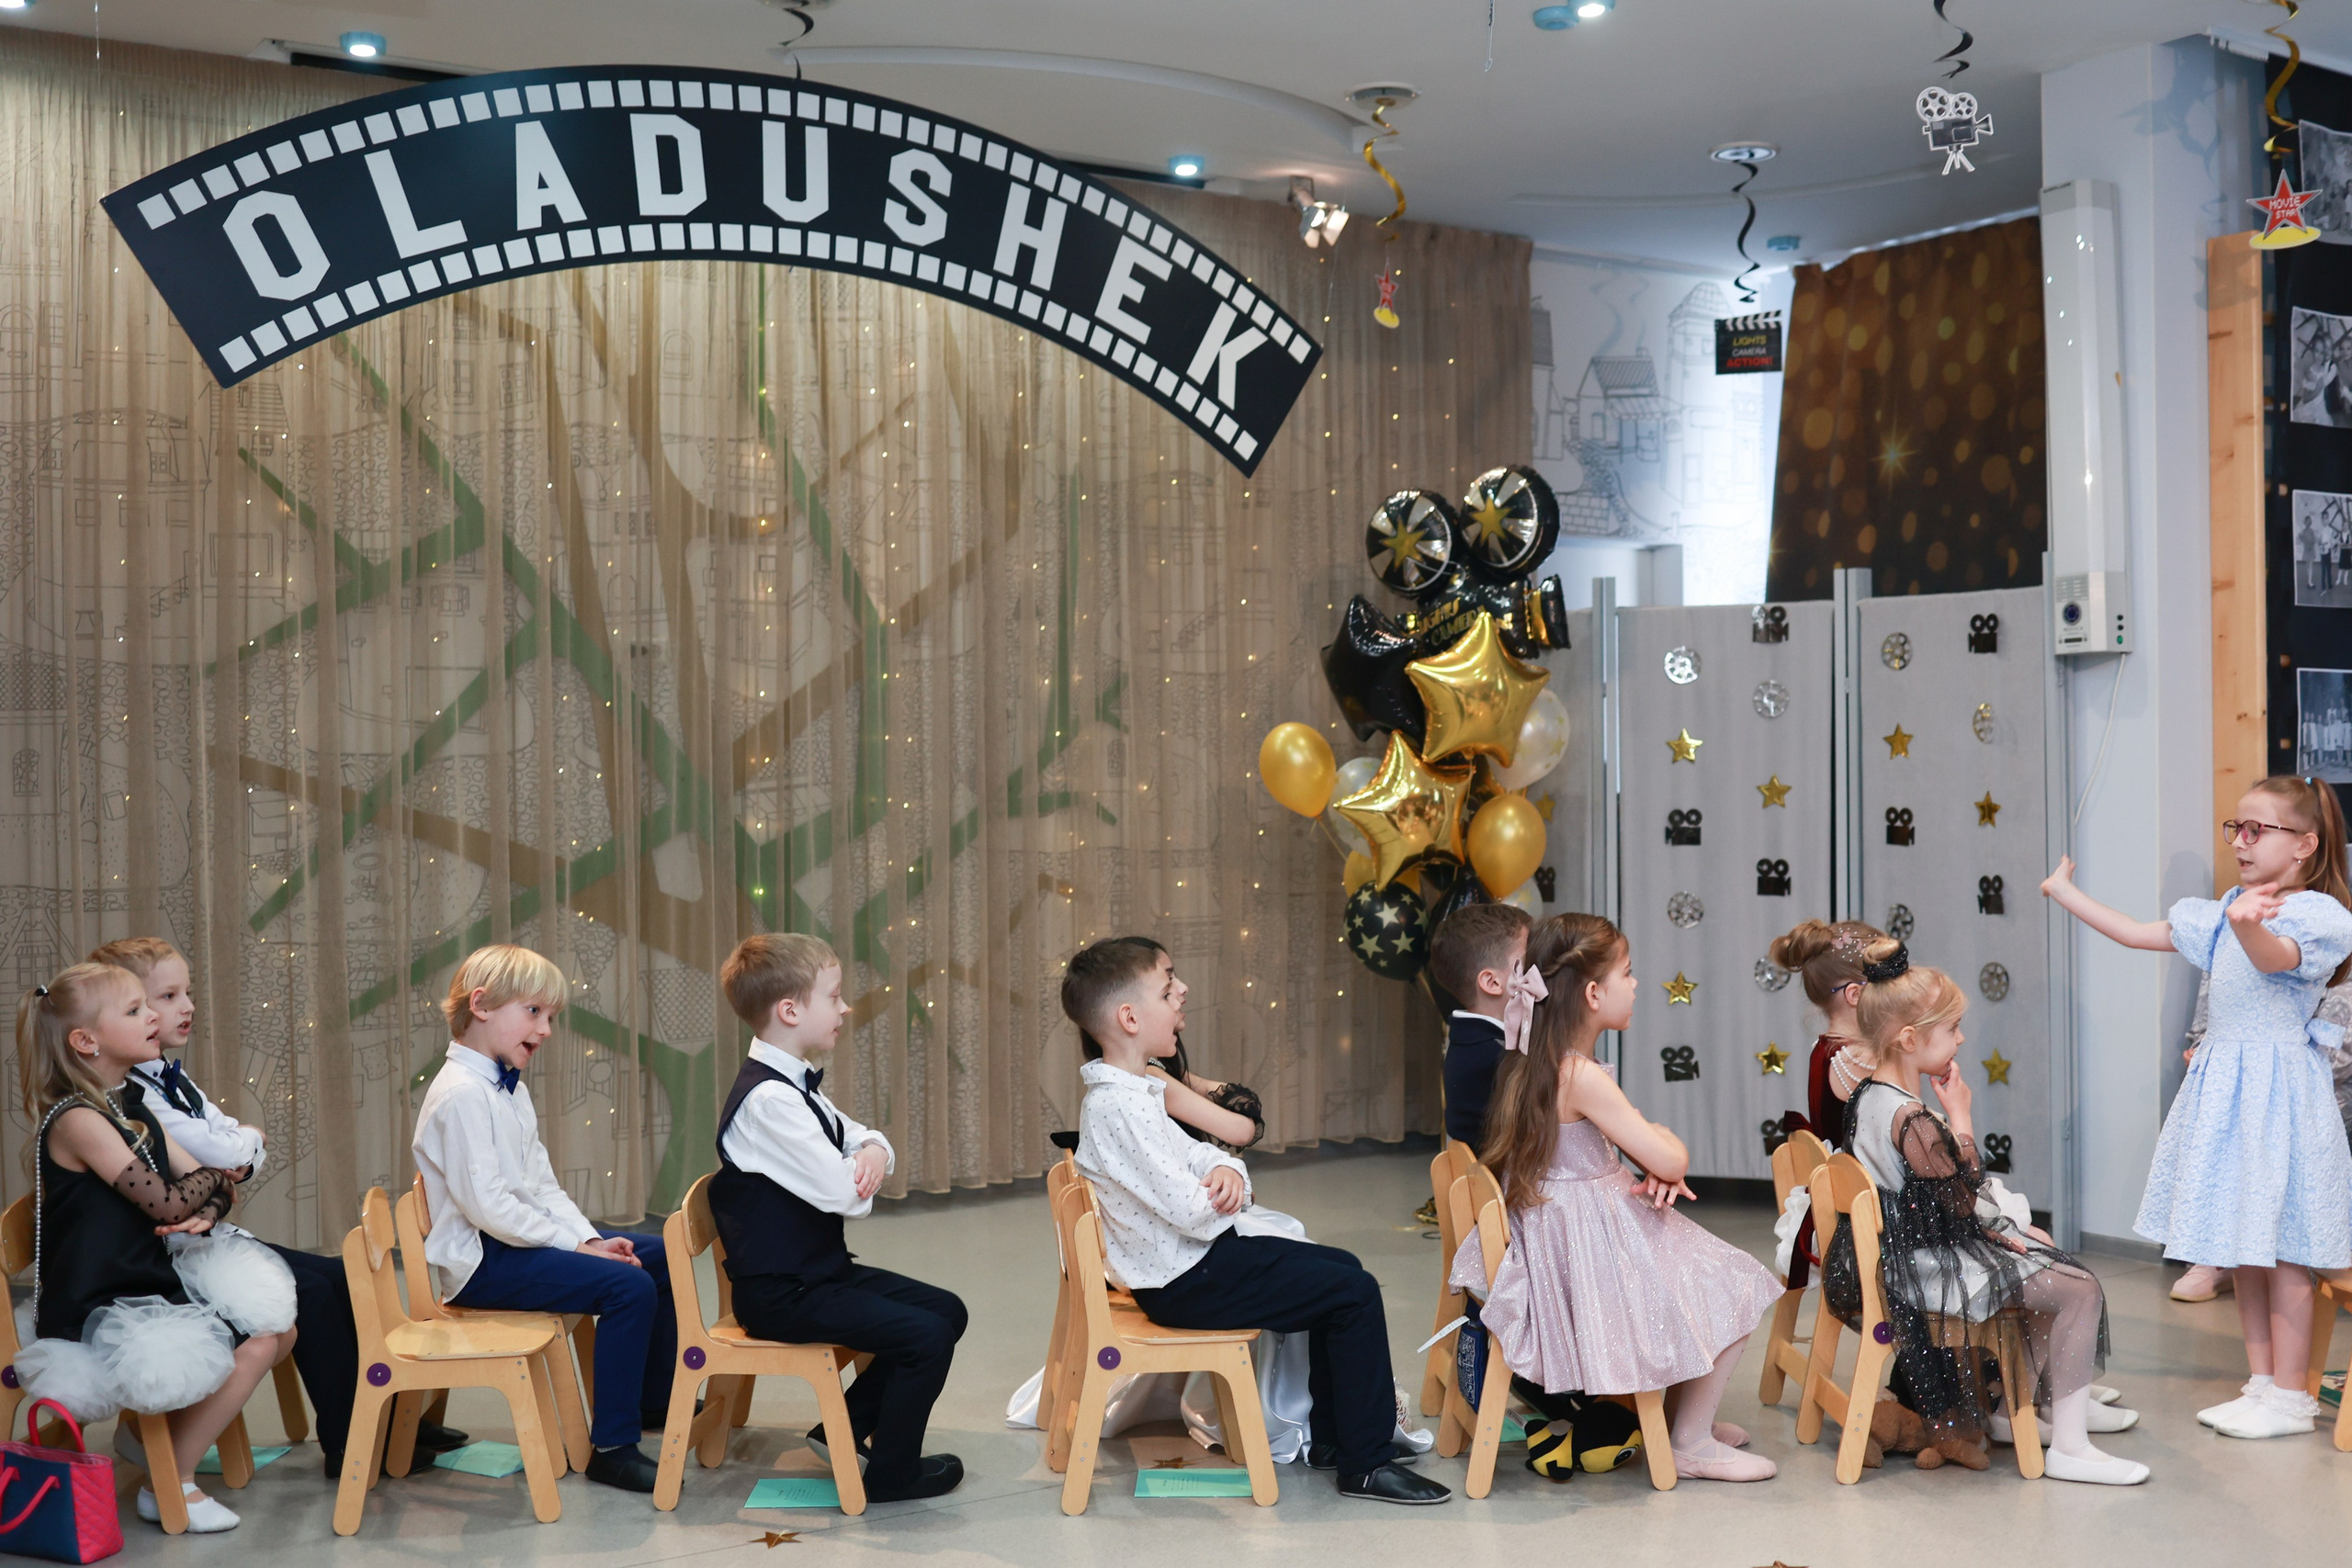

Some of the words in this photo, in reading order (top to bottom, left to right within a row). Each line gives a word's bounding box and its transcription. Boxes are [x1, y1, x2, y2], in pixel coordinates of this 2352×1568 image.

[2269, 196, 2301, 209] MOVIE
[222, 112, 1269, 412] OLADUSHEK
[1733, 335, 1767, 346] LIGHTS
[1732, 347, 1767, 357] CAMERA
[1726, 356, 1773, 367] ACTION!
